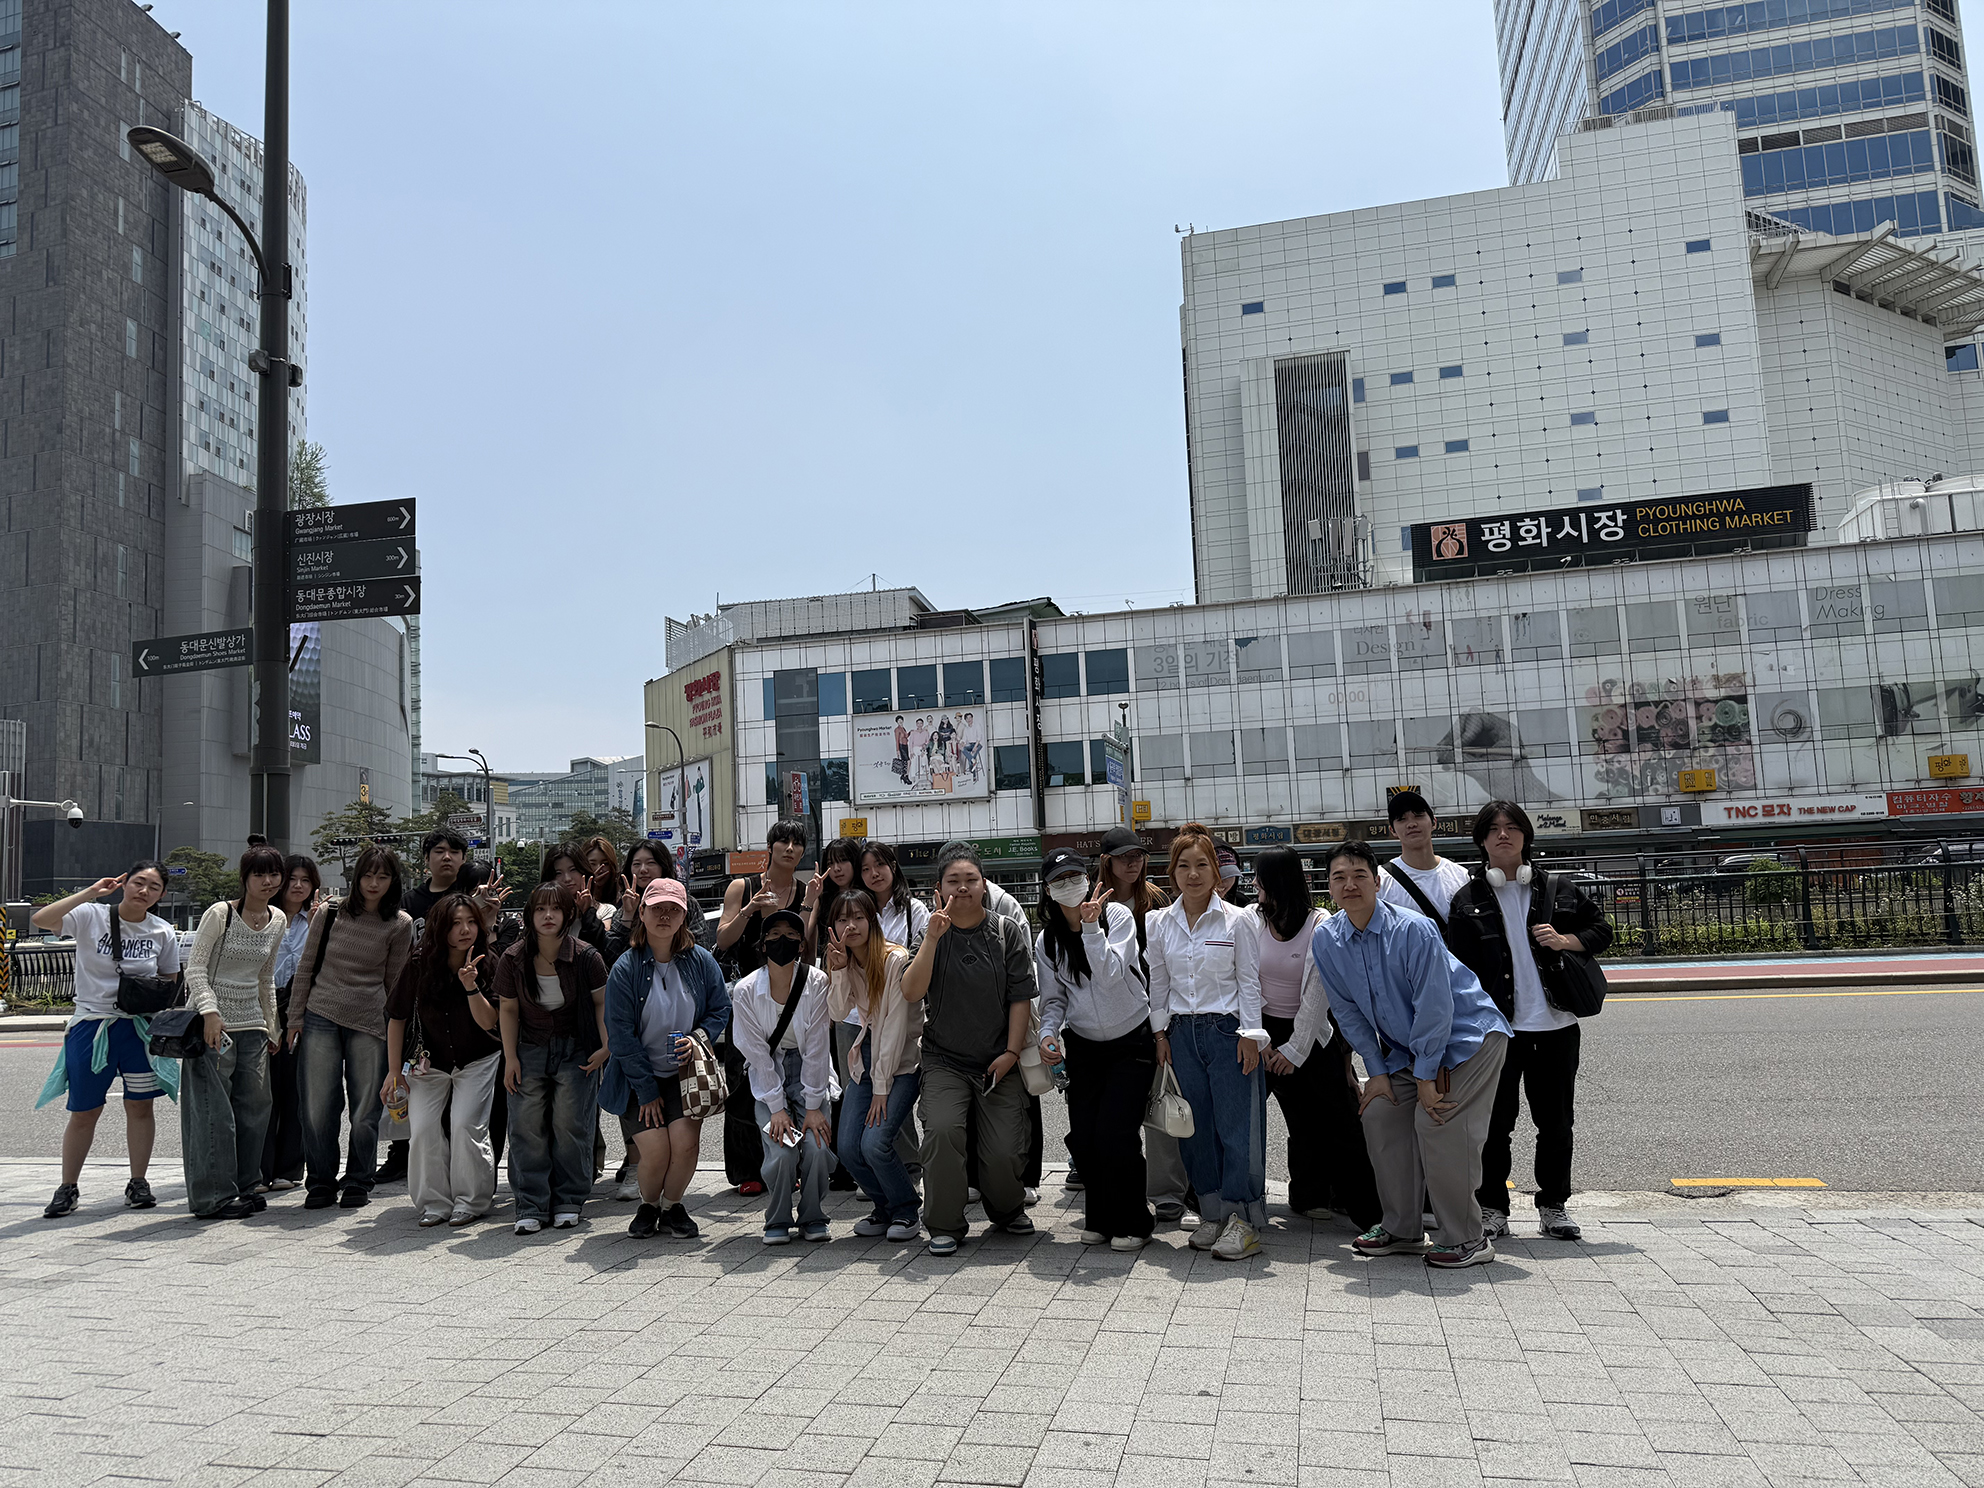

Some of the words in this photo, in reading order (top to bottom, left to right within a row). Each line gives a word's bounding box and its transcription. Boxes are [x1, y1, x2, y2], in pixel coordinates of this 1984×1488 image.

[1636, 498, 1746, 521] PYOUNGHWA
[295, 510, 335, 527] 광장시장
[1637, 516, 1723, 538] CLOTHING
[1726, 509, 1794, 530] MARKET
[295, 526, 324, 535] Gwangjang
[1480, 509, 1628, 553] 평화시장
[297, 550, 334, 566] 신진시장
[296, 566, 310, 574] Sinjin
[296, 585, 367, 603] 동대문종합시장
[1815, 586, 1862, 602] Dress
[296, 603, 330, 611] Dongdaemun
[1693, 594, 1732, 615] 원단
[1816, 601, 1885, 620] Making
[1717, 613, 1769, 629] fabric
[180, 634, 245, 654] 동대문신발상가
[1356, 640, 1415, 657] Design
[180, 651, 212, 661] Dongdaemun
[213, 649, 227, 657] Shoes
[1153, 652, 1199, 675] 3일의
[1724, 806, 1758, 819] TNC
[1762, 803, 1792, 817] 모자
[1797, 807, 1816, 815] THE
[1816, 806, 1836, 814] NEW
[1838, 804, 1857, 813] CAP
[1369, 825, 1387, 835] 밍키
[1076, 840, 1100, 849] HAT'S
[98, 933, 153, 949] AANCED
